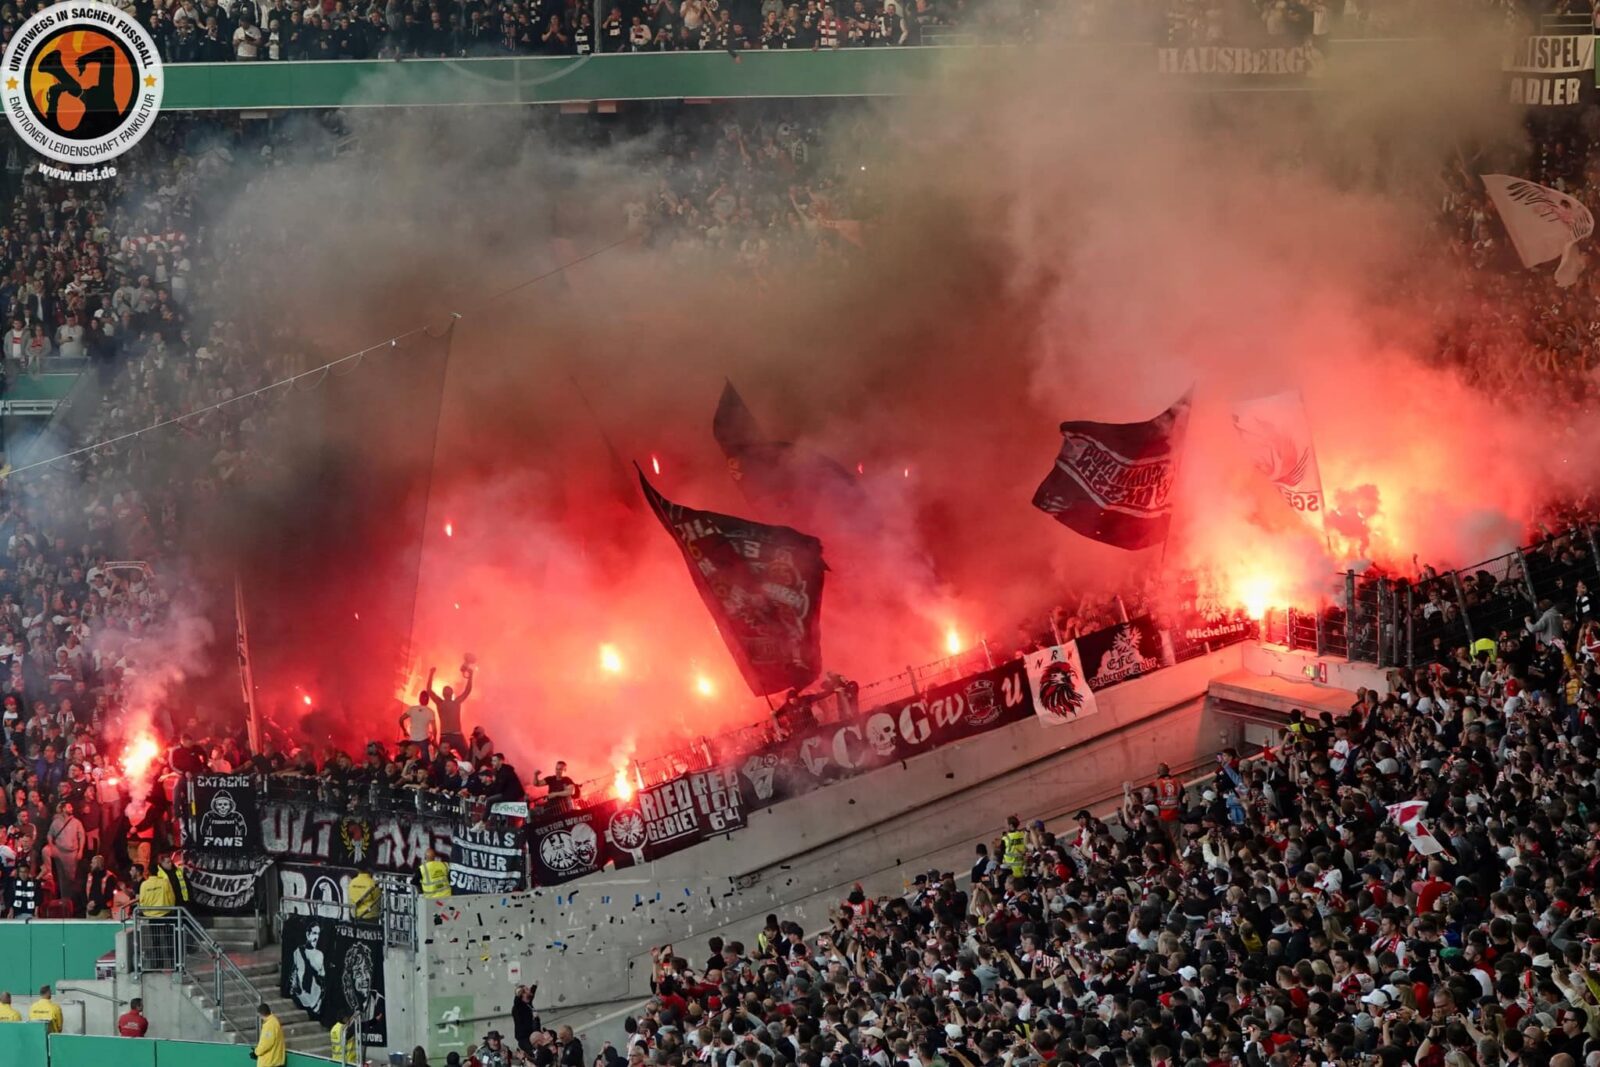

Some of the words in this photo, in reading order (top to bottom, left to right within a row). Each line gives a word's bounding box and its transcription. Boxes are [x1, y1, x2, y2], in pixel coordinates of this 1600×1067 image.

[1510, 77, 1580, 105] ADLER
[1186, 622, 1245, 639] Michelnau
[197, 775, 250, 788] EXTREME
[639, 778, 693, 823] RIED
[645, 807, 698, 841] GEBIET
[708, 806, 741, 831] 64
[203, 837, 243, 847] FANS
[458, 823, 516, 848] ULTRAS
[462, 848, 507, 871] NEVER
